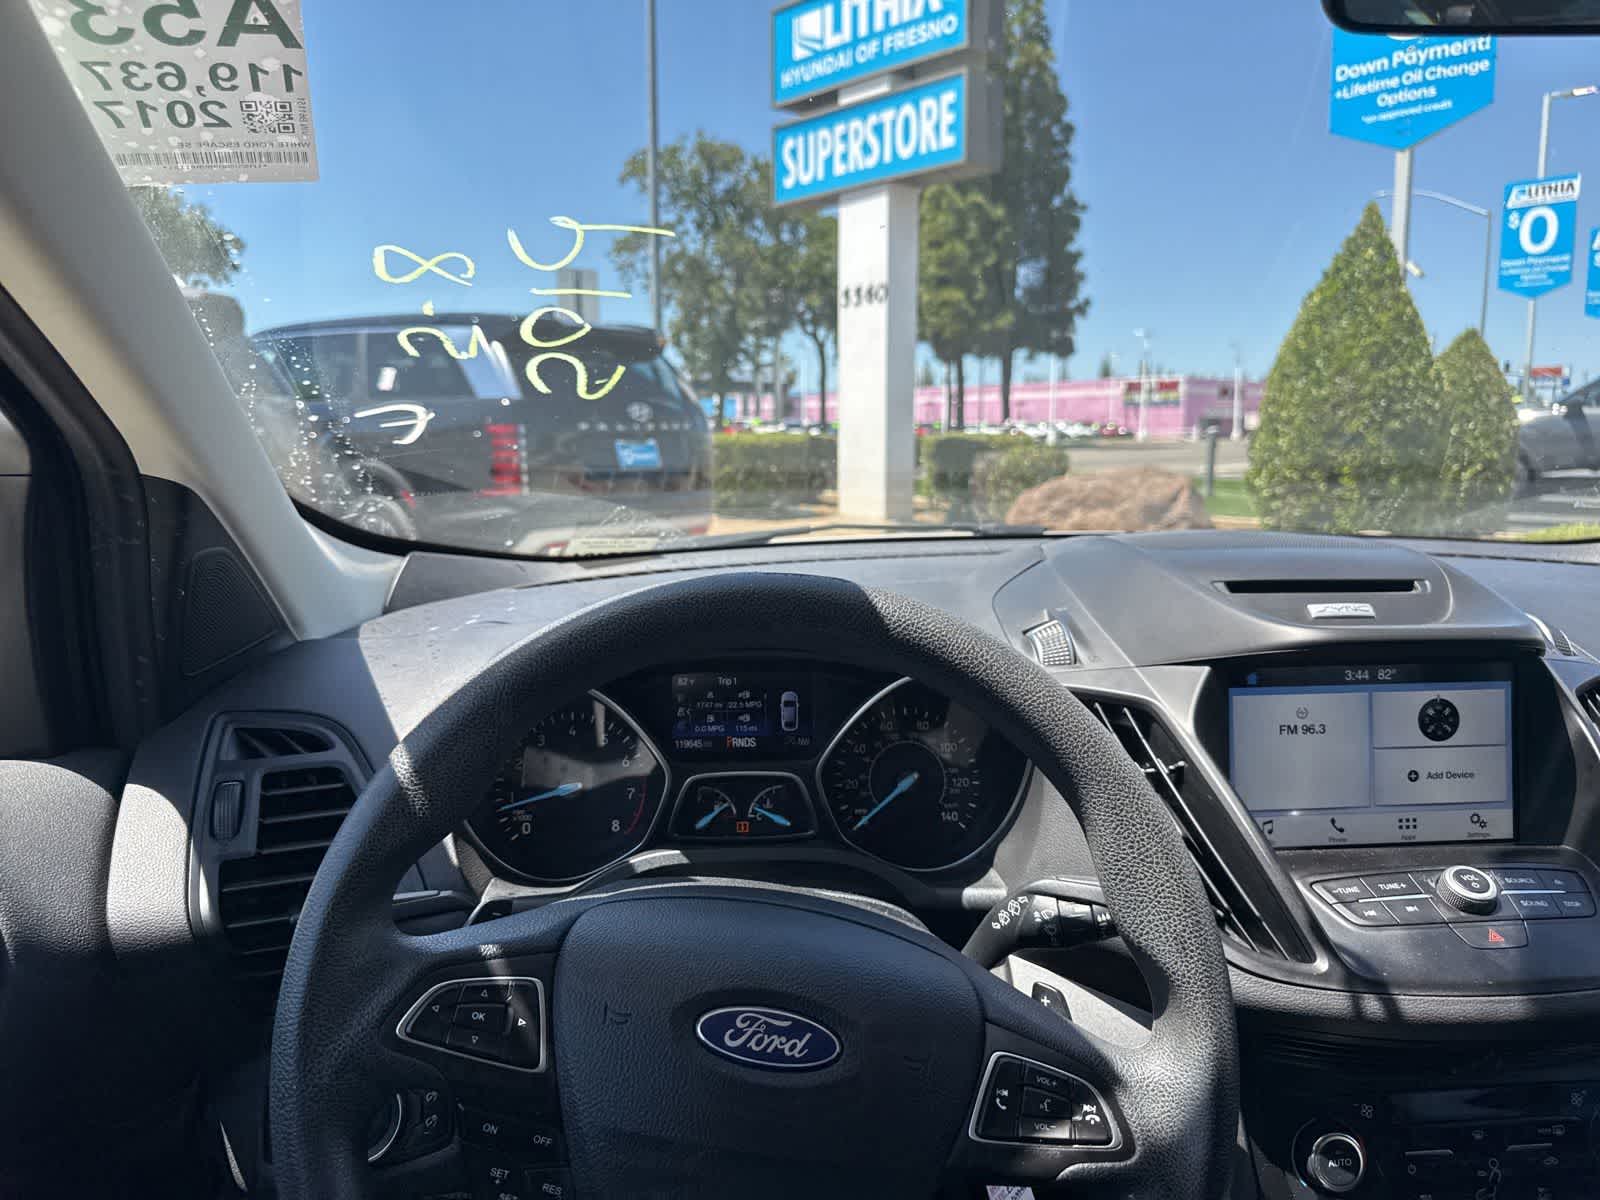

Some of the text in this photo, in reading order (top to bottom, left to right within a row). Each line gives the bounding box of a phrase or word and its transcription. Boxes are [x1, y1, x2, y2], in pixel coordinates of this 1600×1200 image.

[781, 13, 959, 89] HYUNDAI OF FRESNO
[1335, 57, 1390, 83] Down
[1401, 68, 1424, 85] Oil
[1424, 59, 1490, 81] Change
[1376, 85, 1438, 108] Options
[781, 90, 957, 189] SUPERSTORE
[1344, 669, 1370, 681] 3:44
[1279, 723, 1327, 736] FM 96.3
[1425, 768, 1475, 780] Add Device
[627, 787, 636, 800] 7
[521, 822, 532, 835] 0
[611, 819, 621, 833] 8
[471, 1011, 486, 1022] OK
[723, 1012, 812, 1058] Ford
[482, 1123, 499, 1135] ON
[533, 1135, 553, 1147] OFF
[1328, 1157, 1353, 1168] AUTO
[489, 1167, 511, 1179] SET
[542, 1183, 563, 1195] RES
